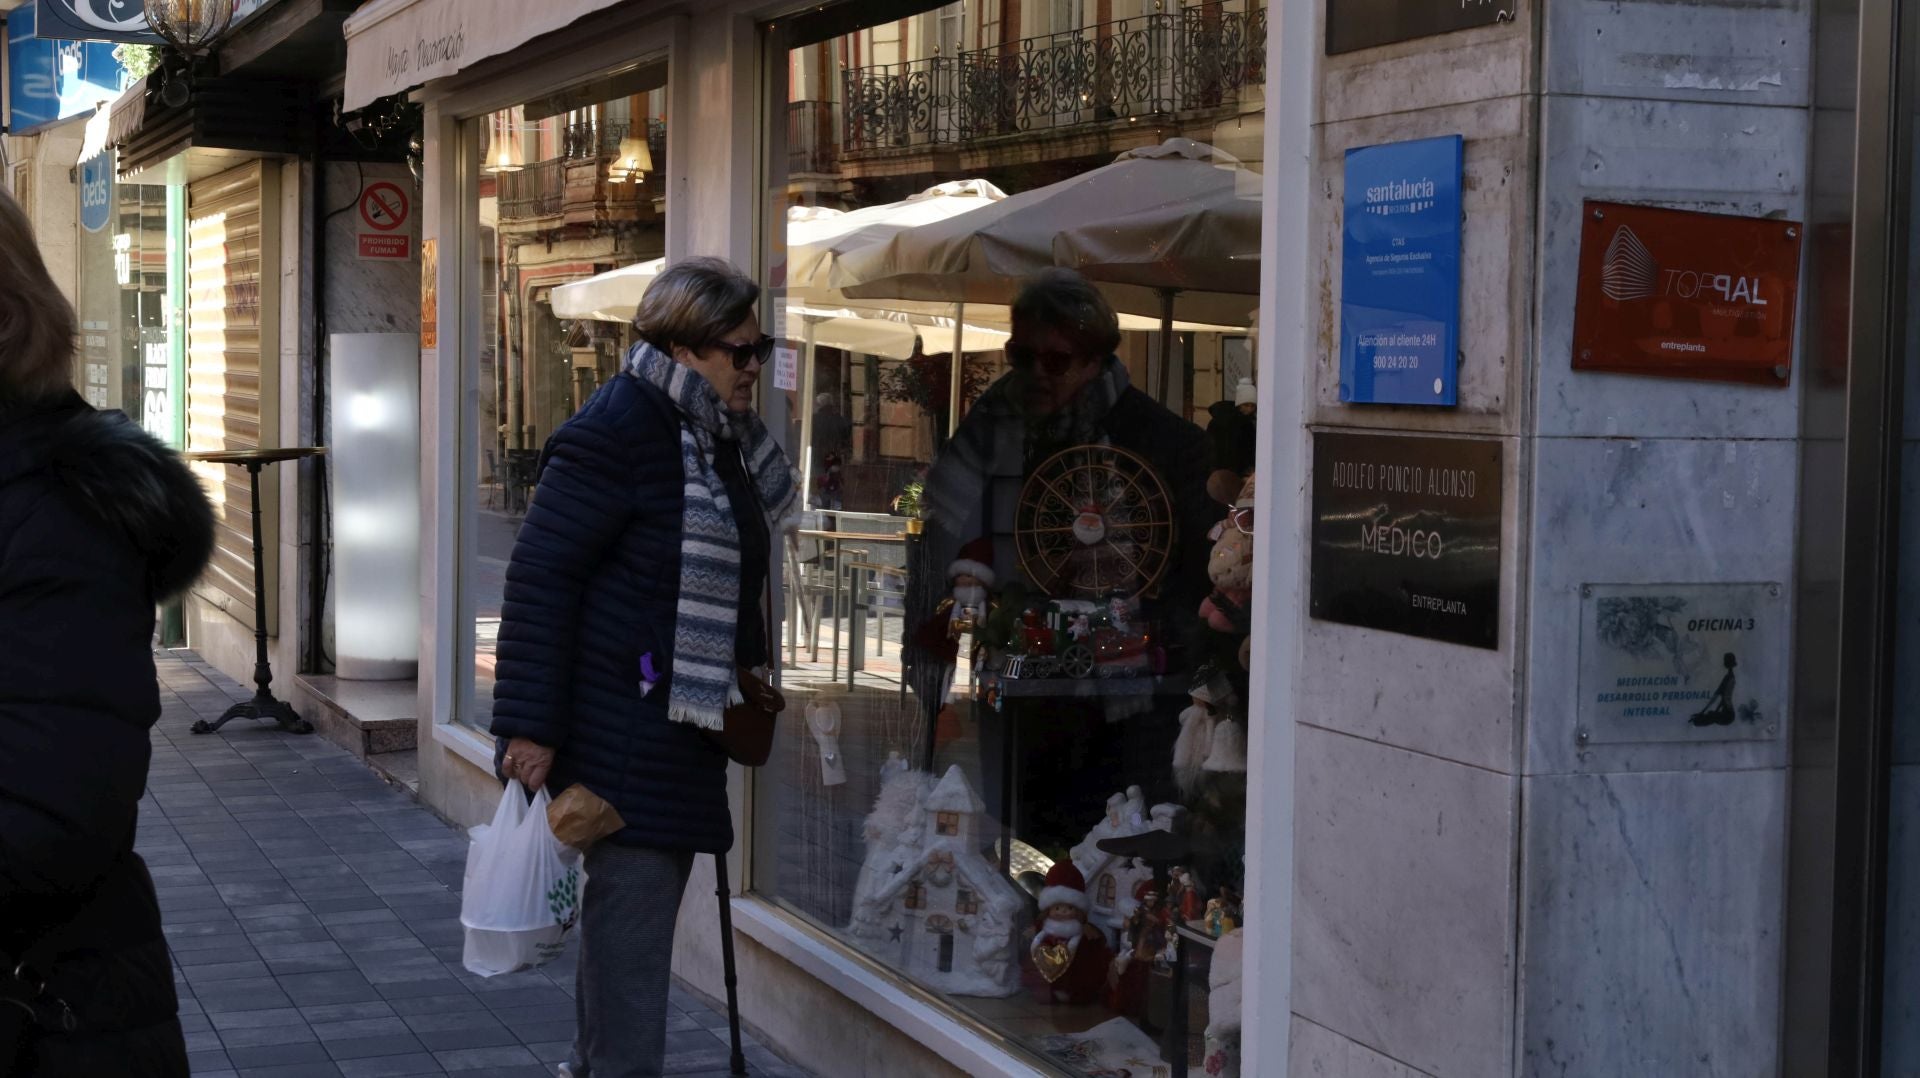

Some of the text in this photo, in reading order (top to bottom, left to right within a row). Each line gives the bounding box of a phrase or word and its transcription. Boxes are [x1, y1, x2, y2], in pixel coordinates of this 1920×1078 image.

[1366, 177, 1434, 203] santalucía
[362, 237, 405, 246] PROHIBIDO
[370, 247, 398, 255] FUMAR
[1358, 333, 1436, 346] Atención al cliente 24H
[1661, 341, 1706, 353] entreplanta
[1373, 355, 1419, 369] 900 24 20 20
[1332, 461, 1476, 498] ADOLFO PONCIO ALONSO
[1412, 594, 1467, 615] ENTREPLANTA
[1687, 618, 1755, 632] OFICINA 3
[1616, 674, 1691, 687] MEDITACIÓN Y
[1597, 689, 1712, 703] DESARROLLO PERSONAL
[1623, 706, 1671, 717] INTEGRAL
